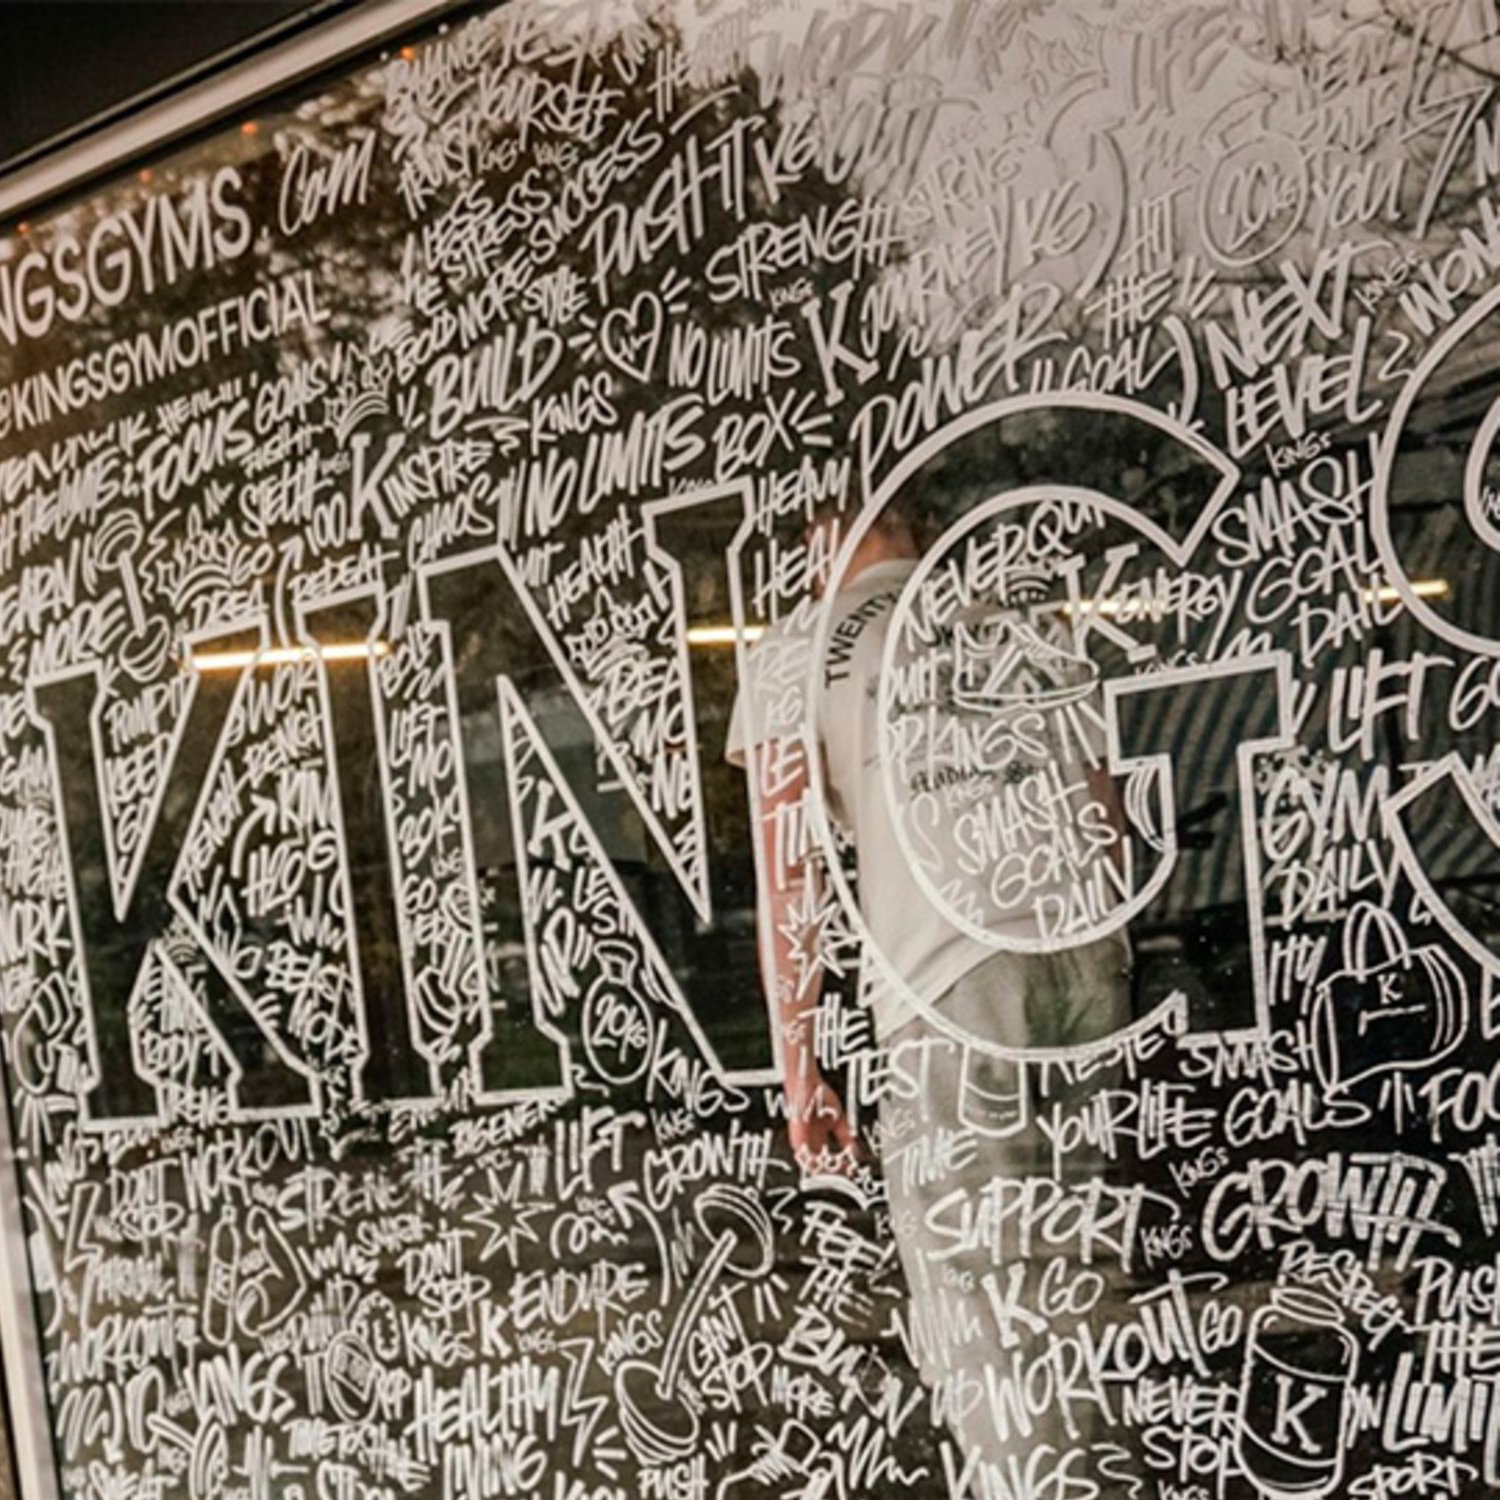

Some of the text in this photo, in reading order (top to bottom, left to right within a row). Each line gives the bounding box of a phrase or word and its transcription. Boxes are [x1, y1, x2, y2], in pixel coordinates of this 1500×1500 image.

[580, 135, 705, 305] PUSH
[1204, 240, 1397, 389] NEXT
[425, 317, 563, 440] BUILD
[850, 283, 1068, 506] POWER
[1227, 315, 1384, 459] LEVEL
[138, 399, 255, 520] FOCUS
[712, 388, 796, 481] BOX
[1210, 433, 1382, 568] SMASH
[1112, 568, 1244, 662] ENERGY
[1327, 649, 1455, 761] LIFT
[952, 760, 1090, 876] SMASH
[991, 802, 1120, 909] GOALS
[1033, 835, 1132, 941] DAILY
[1264, 838, 1402, 933] DAILY
[646, 1018, 750, 1117] KINGS
[1224, 1076, 1373, 1147] GOALS
[554, 1105, 647, 1201] LIFT
[643, 1119, 791, 1211] GROWTH
[924, 1175, 1183, 1275] SUPPORT
[1202, 1151, 1462, 1273] GROWTH
[508, 1259, 651, 1342] ENDURE
[404, 1356, 562, 1467] HEALTHY
